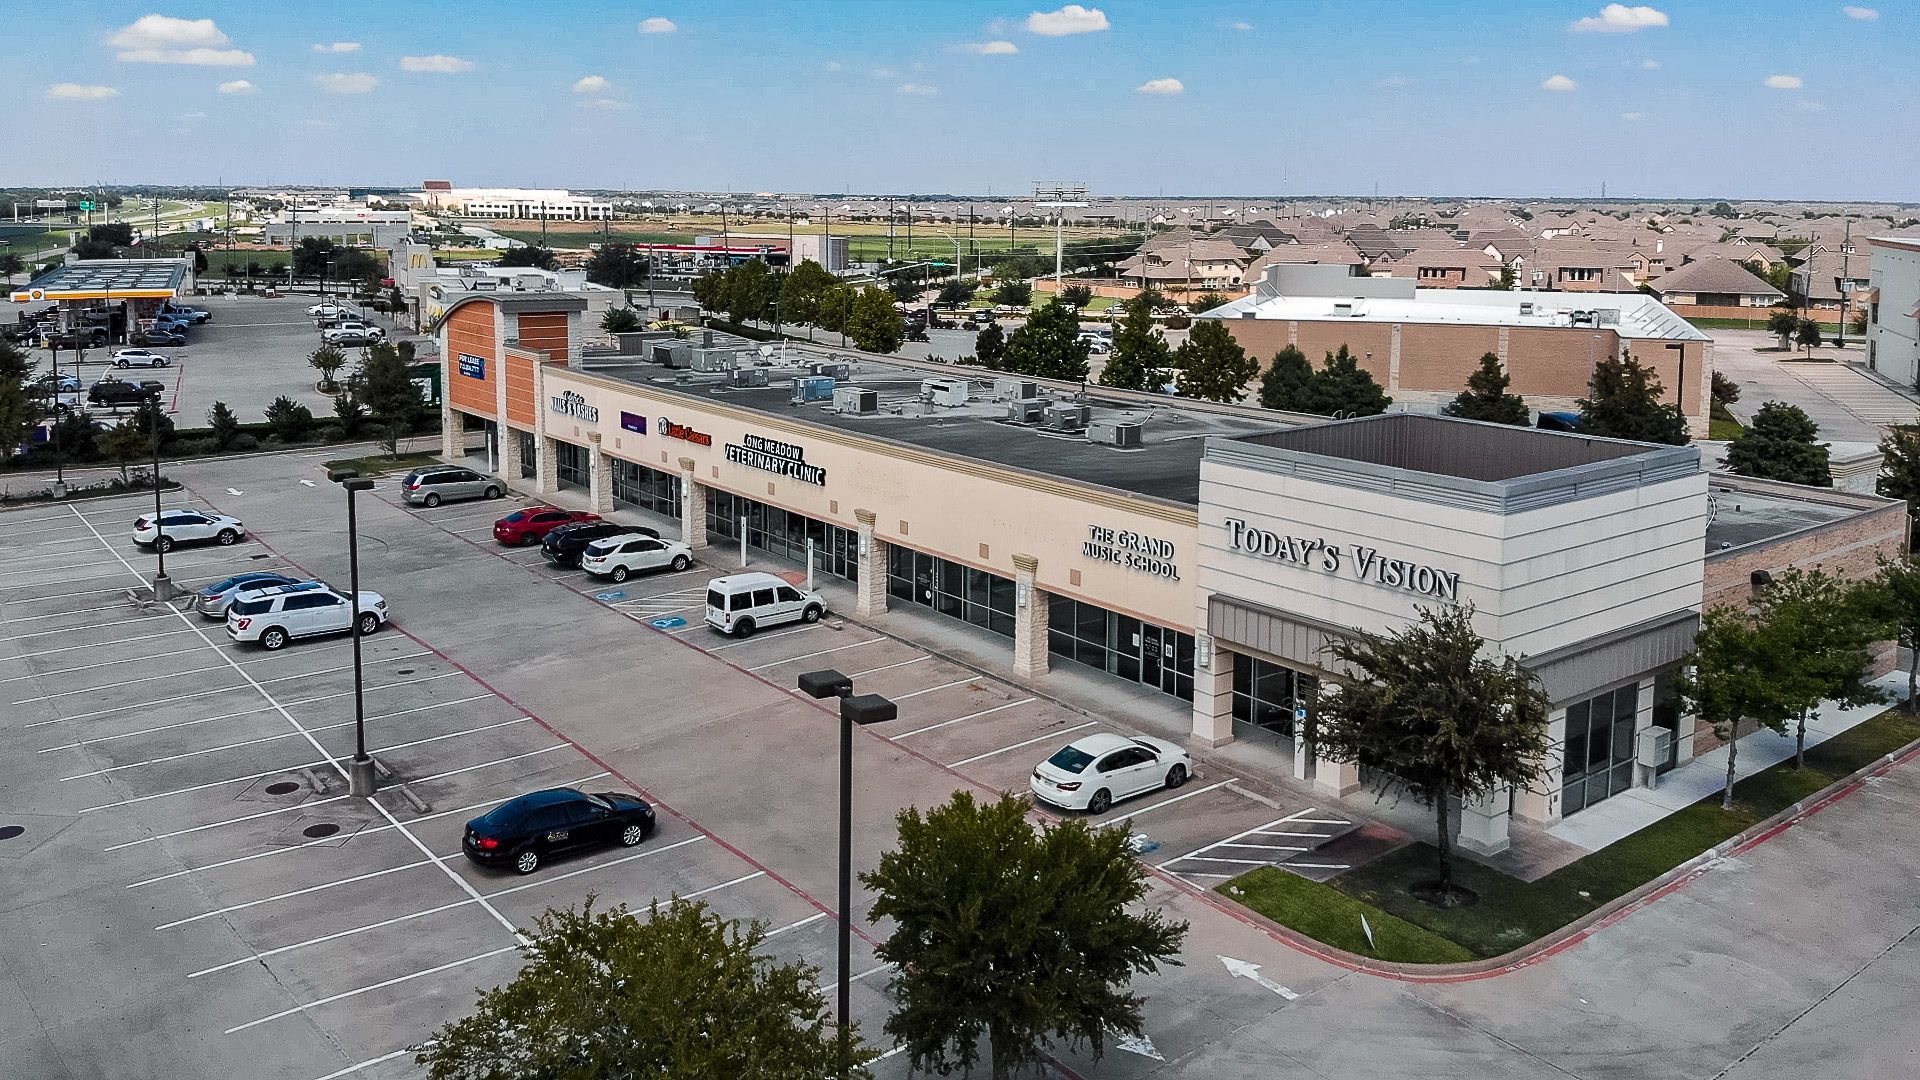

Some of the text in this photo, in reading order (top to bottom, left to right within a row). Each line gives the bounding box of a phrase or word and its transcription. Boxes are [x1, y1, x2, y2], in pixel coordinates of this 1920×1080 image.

[724, 443, 825, 486] VETERINARY CLINIC
[743, 433, 802, 460] LONG MEADOW
[1082, 541, 1181, 581] MUSIC SCHOOL
[1088, 525, 1175, 559] THE GRAND
[1224, 516, 1459, 600] TODAY'S VISION
